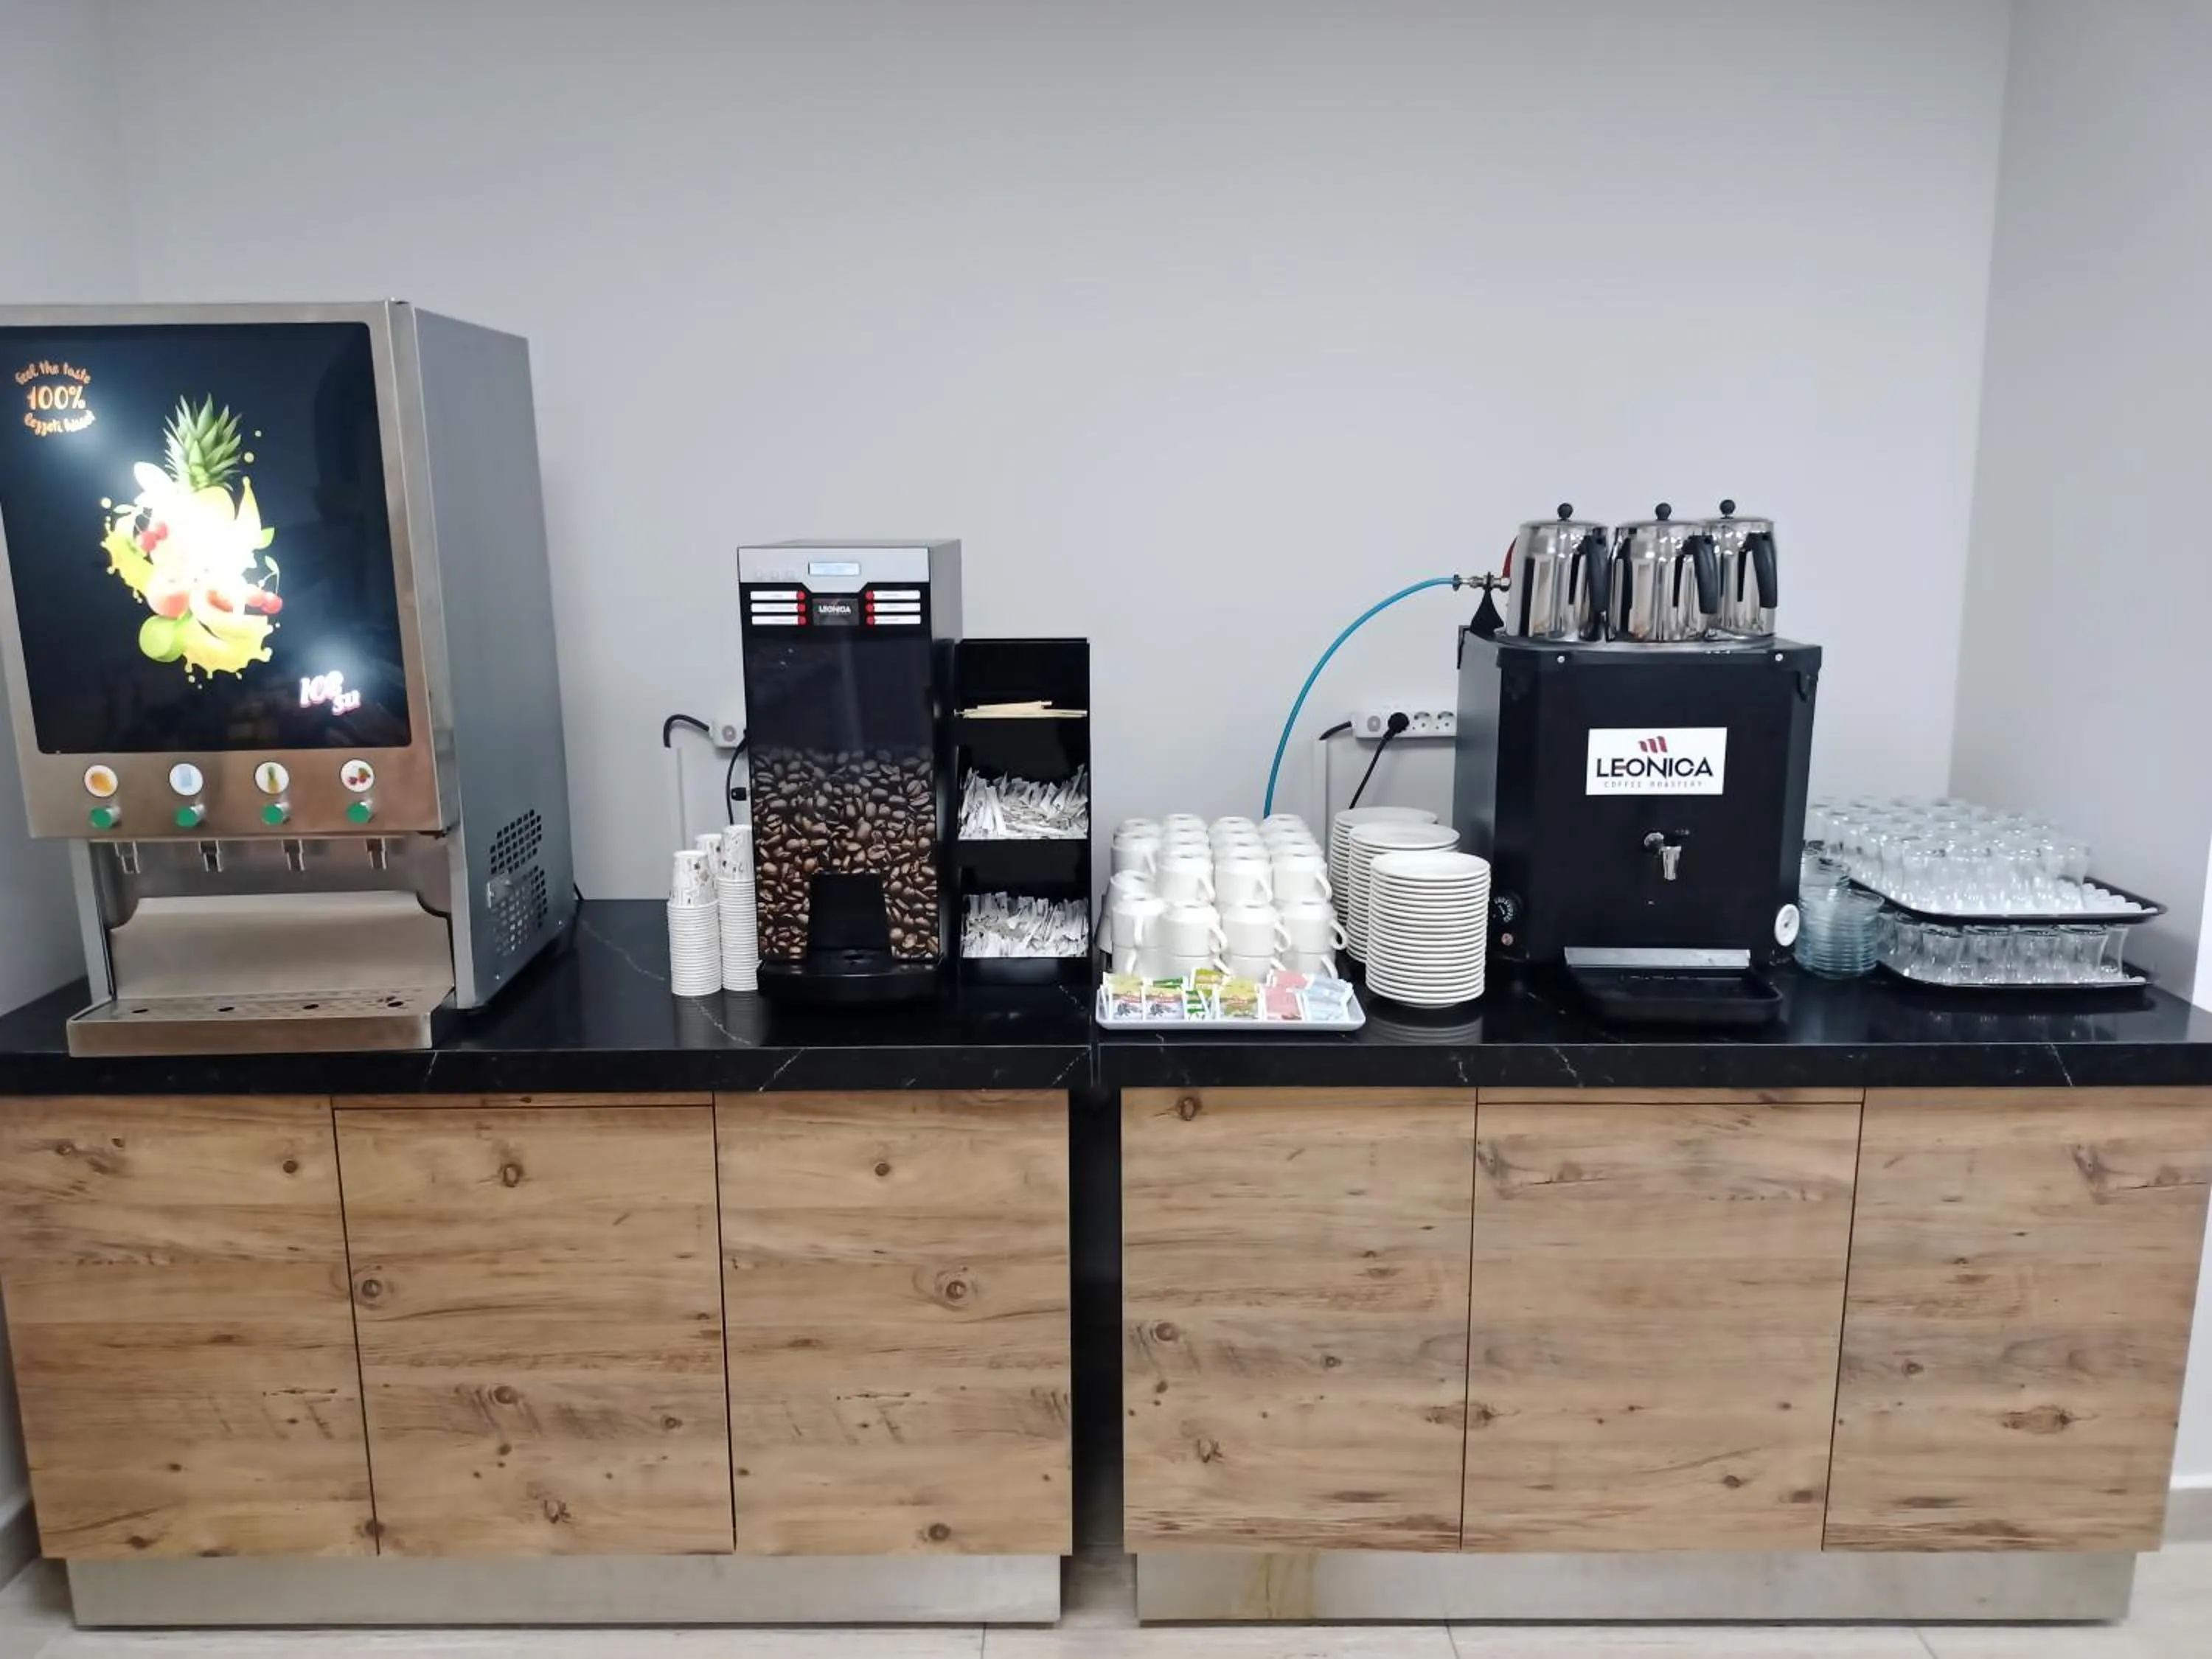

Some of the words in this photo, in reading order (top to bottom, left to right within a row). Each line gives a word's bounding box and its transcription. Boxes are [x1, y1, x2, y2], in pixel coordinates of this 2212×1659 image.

[27, 386, 86, 410] 100%
[1596, 757, 1714, 779] LEONICA
[1604, 780, 1642, 788] COFFEE
